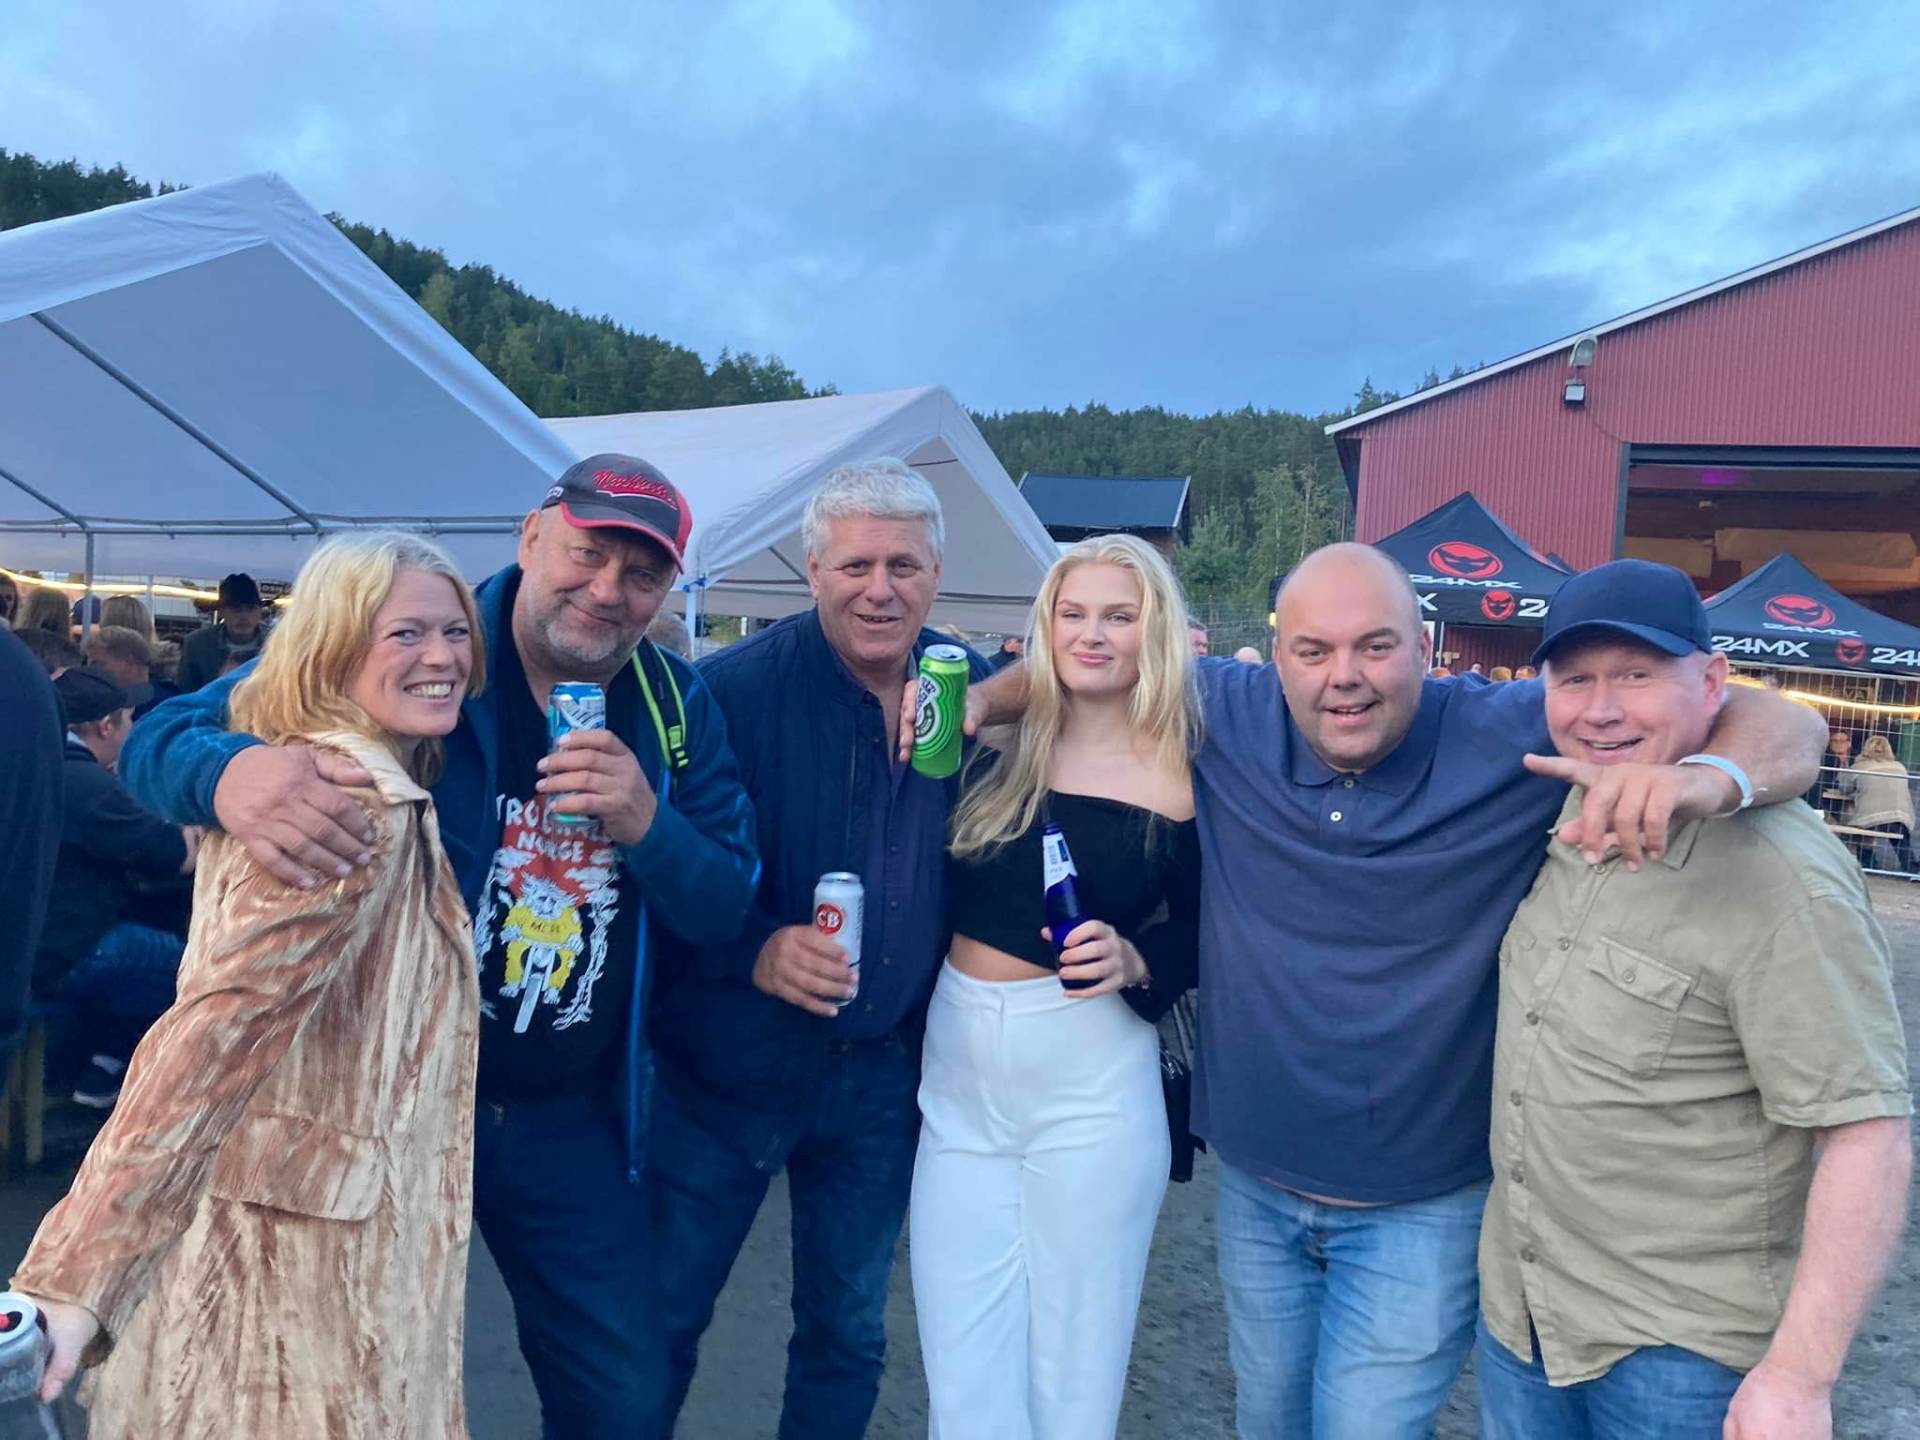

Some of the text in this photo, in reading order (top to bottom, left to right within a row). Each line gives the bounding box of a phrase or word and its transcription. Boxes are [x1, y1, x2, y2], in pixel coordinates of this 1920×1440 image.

[1408, 574, 1523, 589] 24MX
[1762, 622, 1864, 638] 24MX
[1711, 635, 1810, 658] 24MX
[1870, 647, 1920, 667] 24
[816, 911, 840, 928] CB
